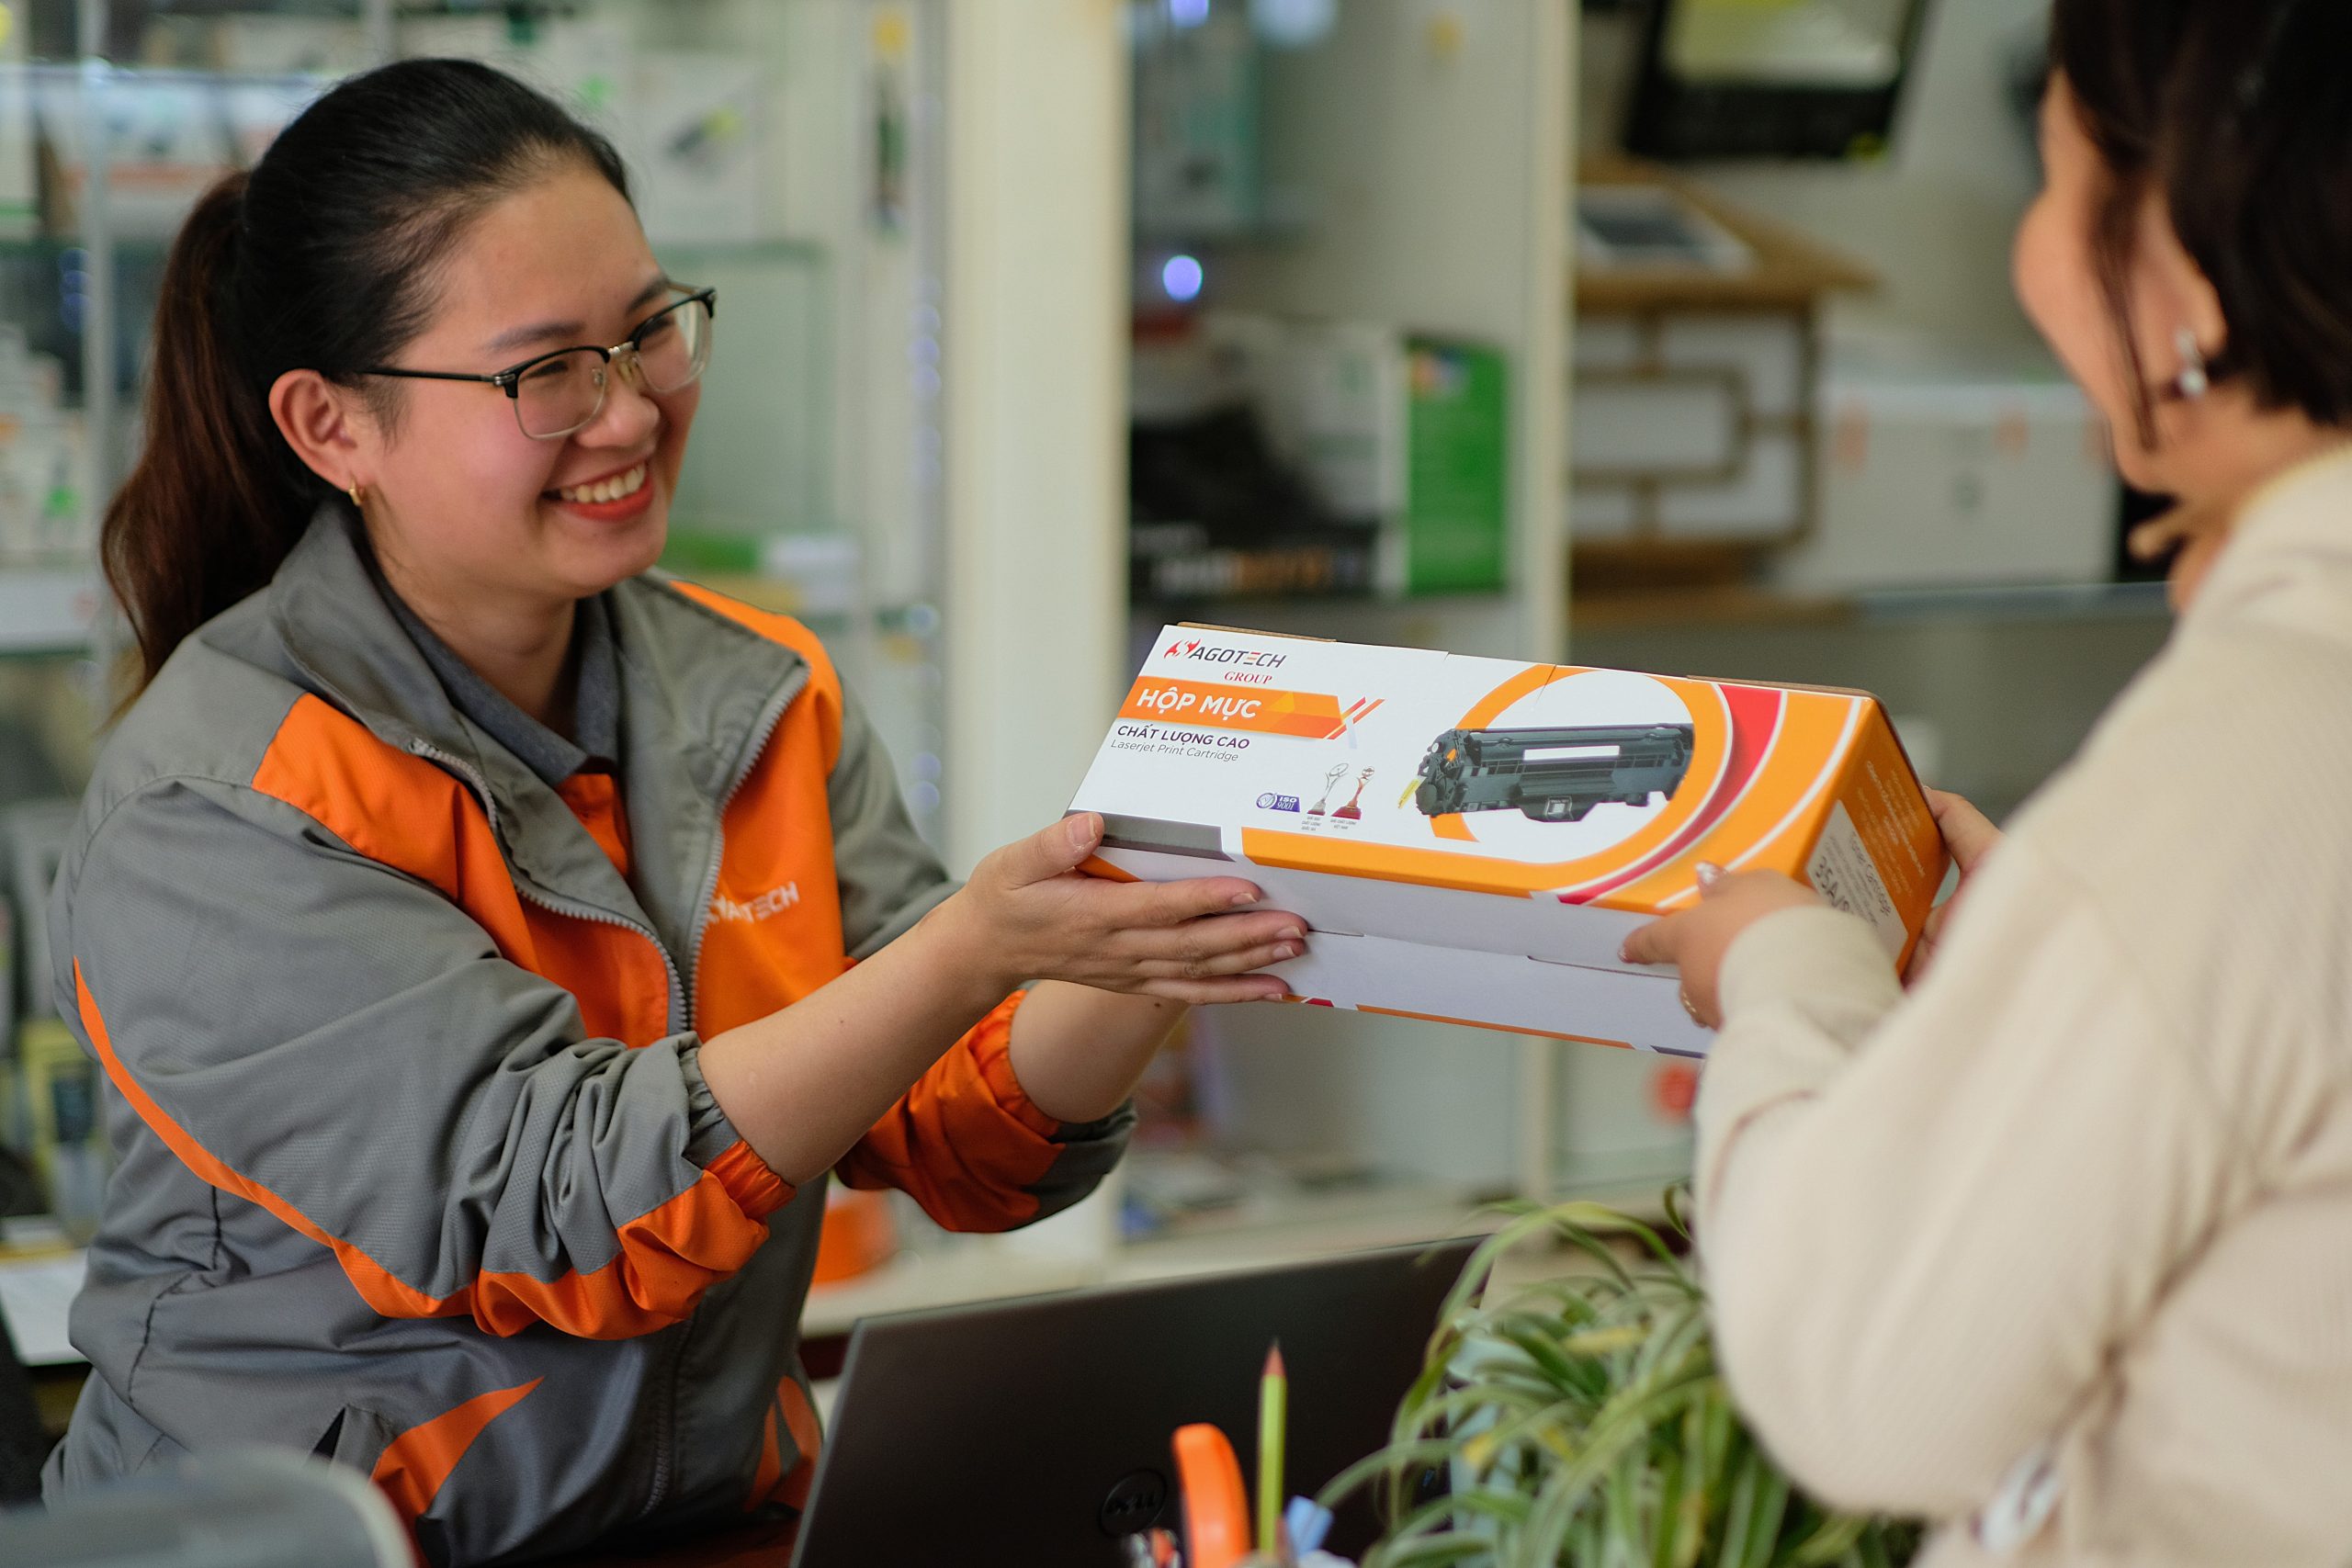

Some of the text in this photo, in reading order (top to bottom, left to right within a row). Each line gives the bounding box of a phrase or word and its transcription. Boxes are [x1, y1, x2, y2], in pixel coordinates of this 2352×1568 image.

[1224, 671, 1272, 684] GROUP
[1136, 686, 1262, 721] HỘP MỰC
[1117, 724, 1250, 750] CHẤT LƯỢNG CAO
[1111, 739, 1238, 762] Laserjet Print Cartridge
[1277, 802, 1295, 810] 9001
